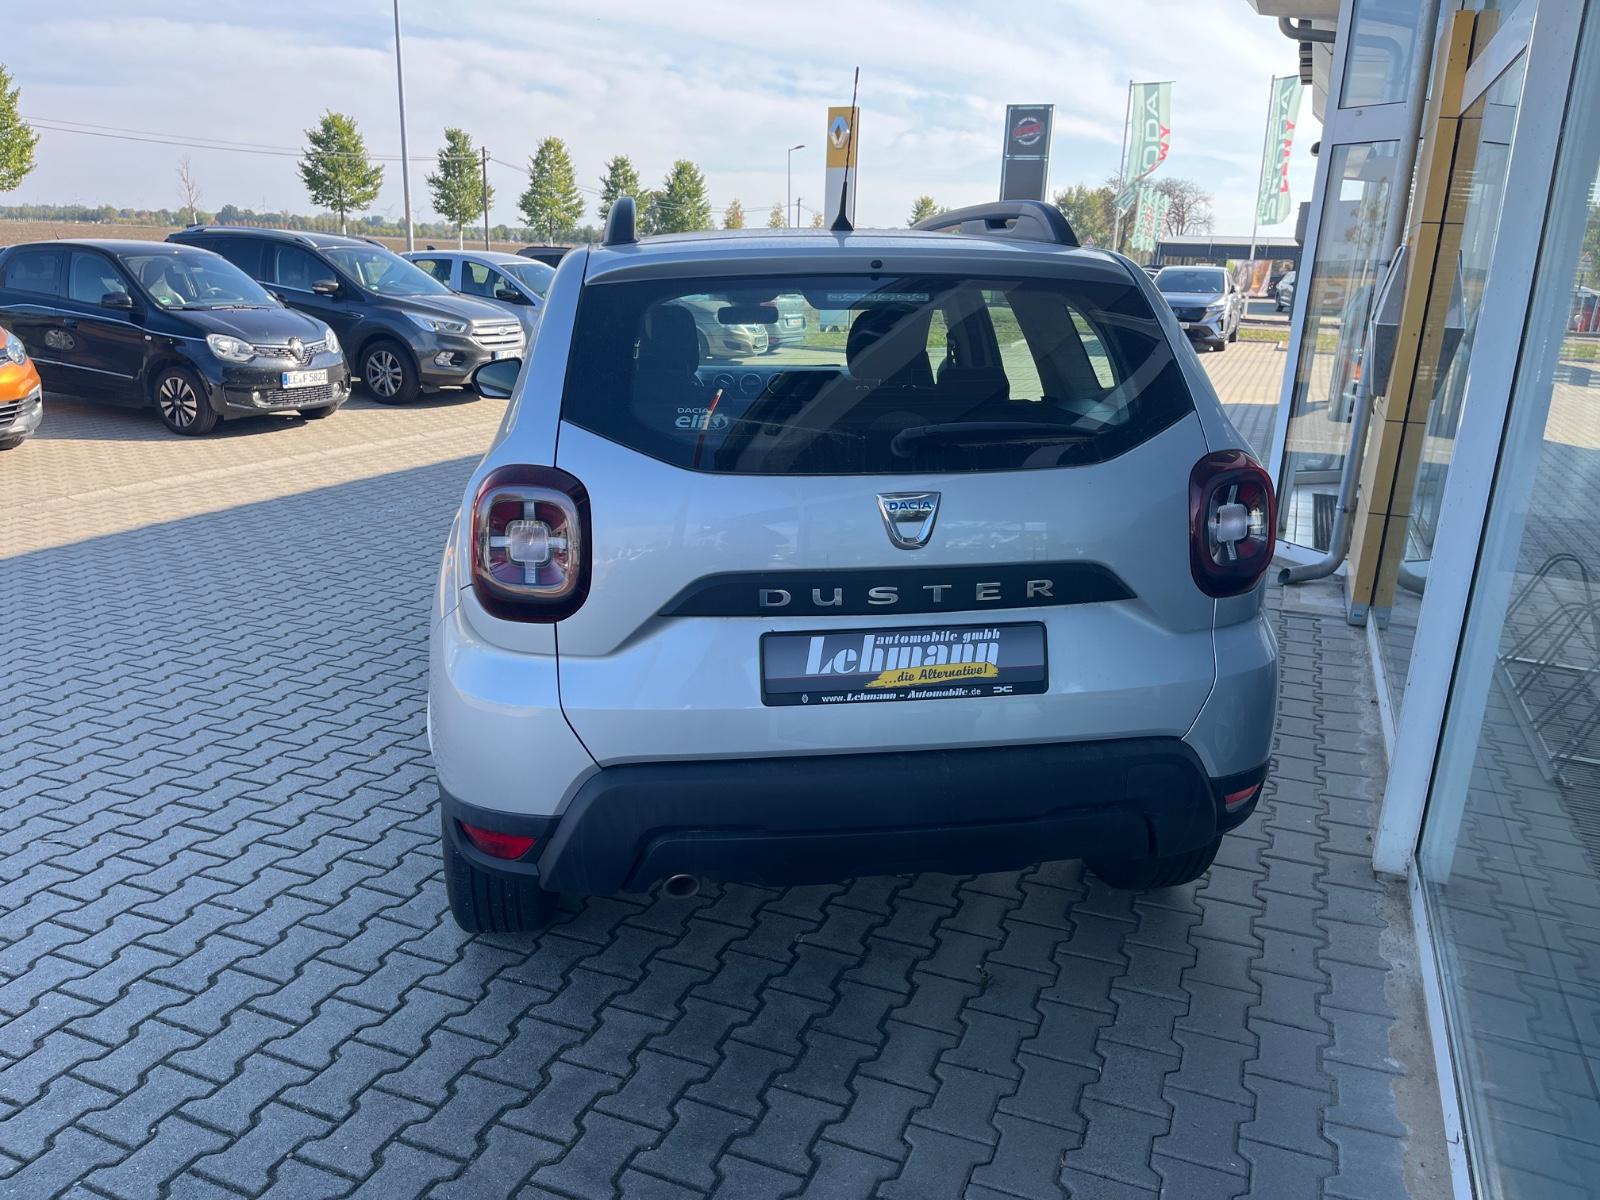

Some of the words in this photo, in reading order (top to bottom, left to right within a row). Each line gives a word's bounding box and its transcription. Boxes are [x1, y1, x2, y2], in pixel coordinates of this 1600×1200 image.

[889, 501, 932, 511] DACIA
[759, 579, 1055, 607] DUSTER
[876, 631, 958, 645] automobile
[962, 629, 1000, 643] gmbh
[805, 635, 1000, 675] Lehmann
[918, 663, 988, 681] Alternative!
